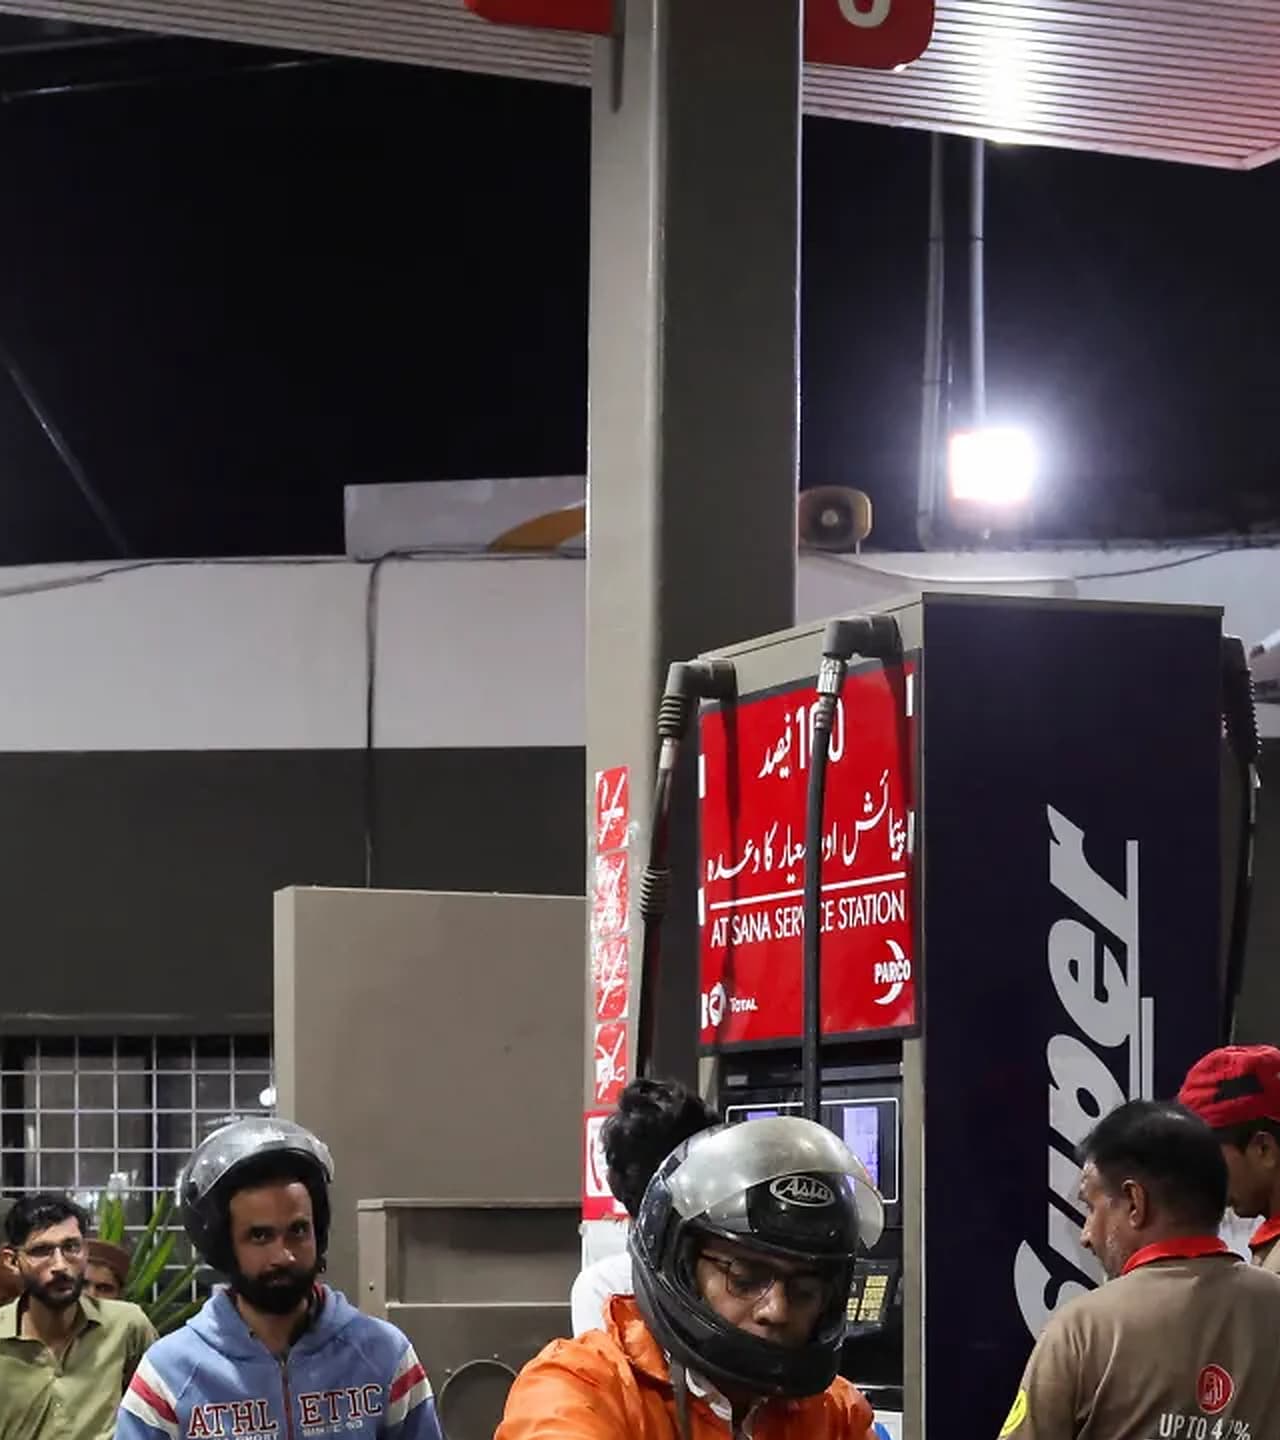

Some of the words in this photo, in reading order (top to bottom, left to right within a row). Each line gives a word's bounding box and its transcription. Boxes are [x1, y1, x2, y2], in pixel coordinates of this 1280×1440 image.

[778, 823, 807, 884] عیار
[710, 916, 729, 949] AT
[731, 911, 772, 946] SANA
[775, 900, 835, 940] SERVCE
[838, 888, 906, 929] STATION
[874, 959, 912, 985] PARCO
[1013, 804, 1154, 1342] Super
